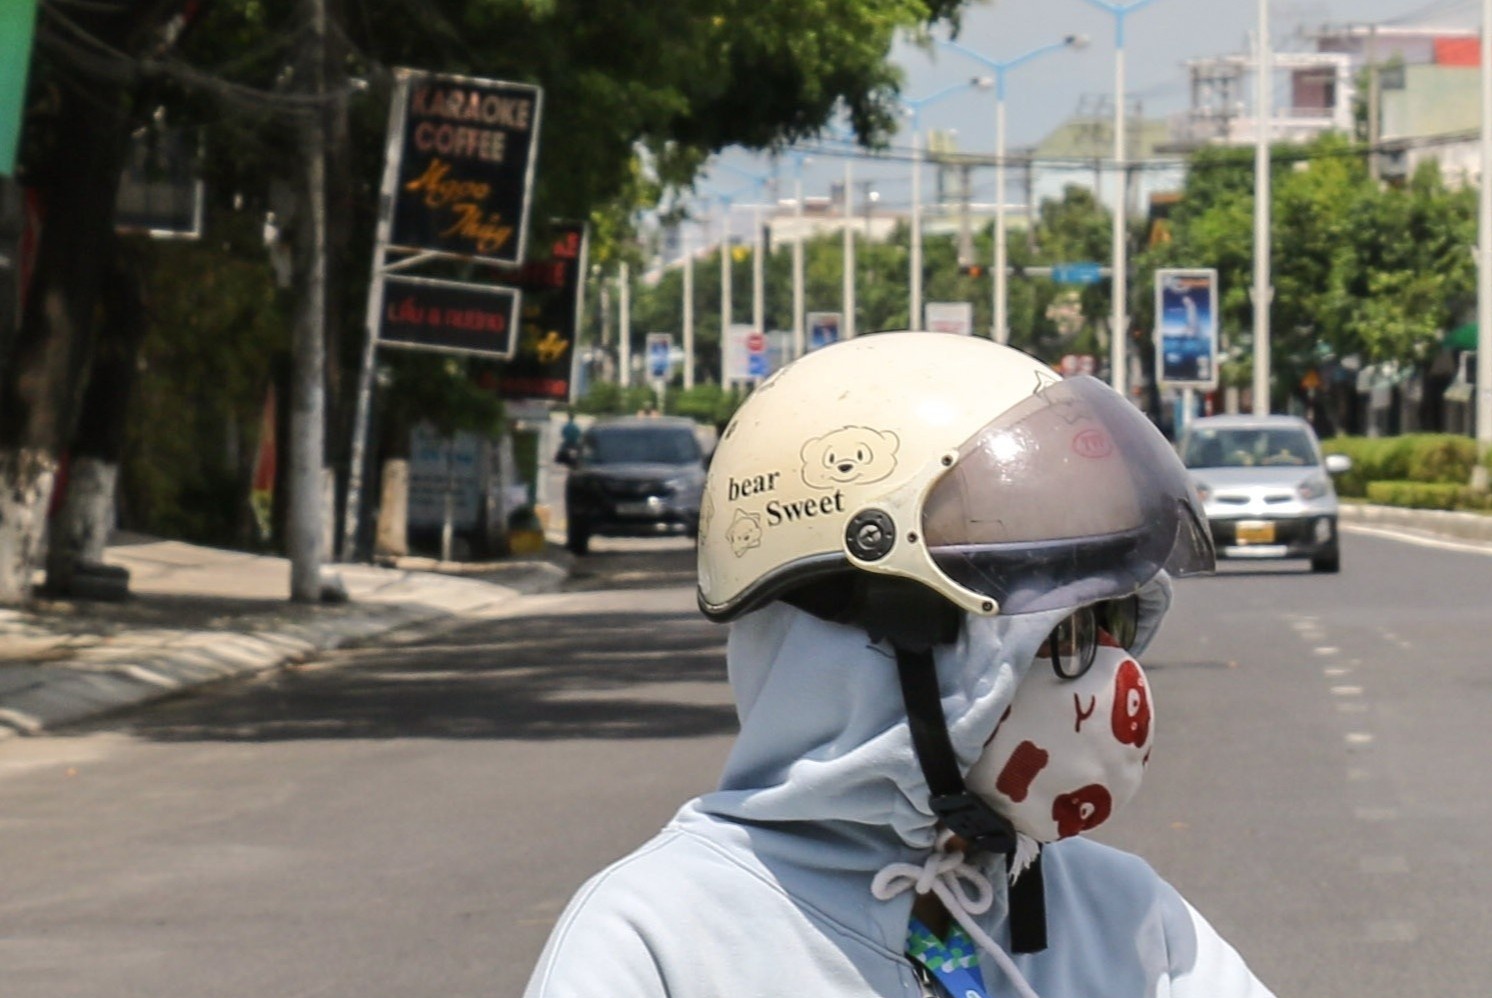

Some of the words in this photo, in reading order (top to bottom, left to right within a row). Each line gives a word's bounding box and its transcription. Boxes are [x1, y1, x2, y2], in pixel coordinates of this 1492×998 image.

[412, 88, 530, 131] KARAOKE
[414, 121, 506, 163] COFFEE
[728, 471, 780, 501] bear
[765, 489, 845, 527] Sweet
